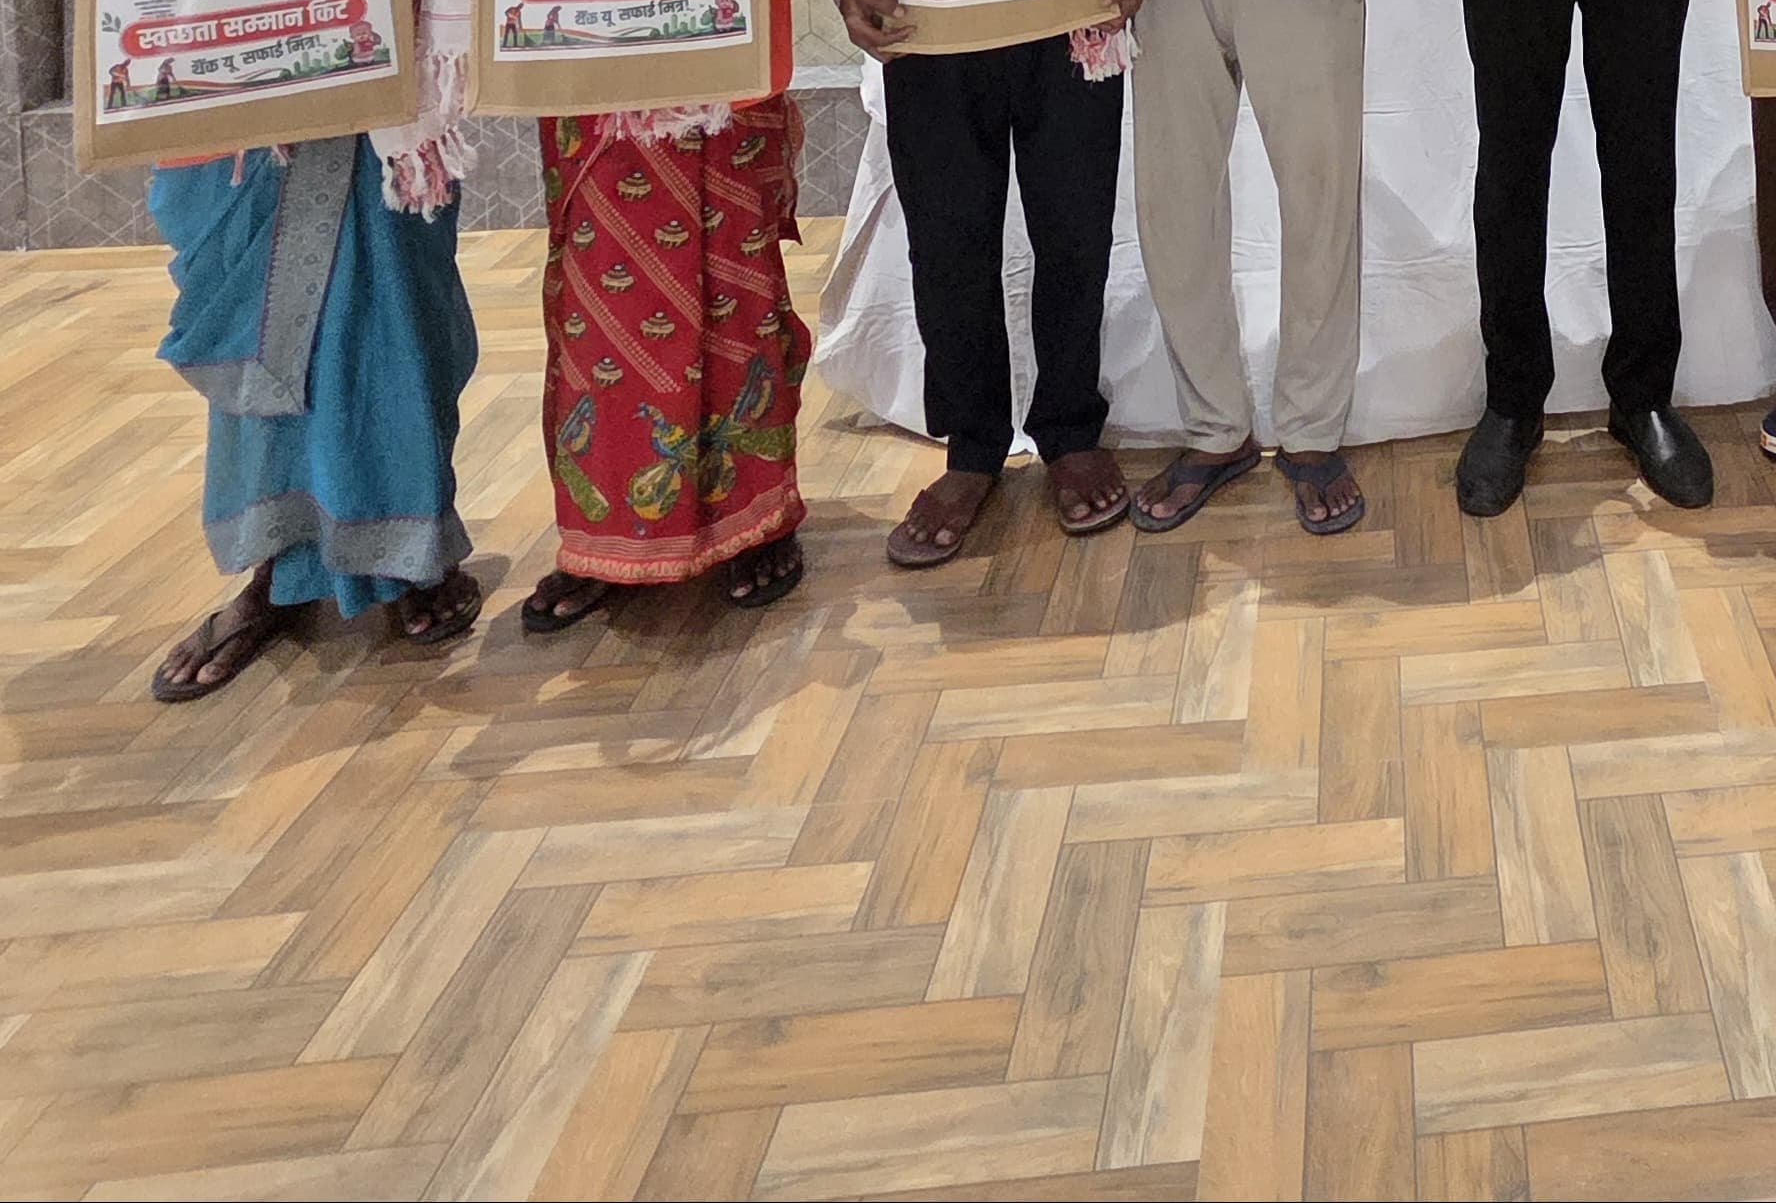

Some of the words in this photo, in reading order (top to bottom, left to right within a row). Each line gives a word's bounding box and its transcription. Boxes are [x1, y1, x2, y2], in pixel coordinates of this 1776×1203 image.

[600, 10, 616, 27] यू
[618, 1, 656, 20] सफाई
[136, 21, 219, 51] स्वच्छता
[222, 8, 303, 38] सम्मान
[222, 55, 239, 74] यू
[240, 45, 284, 66] सफाई
